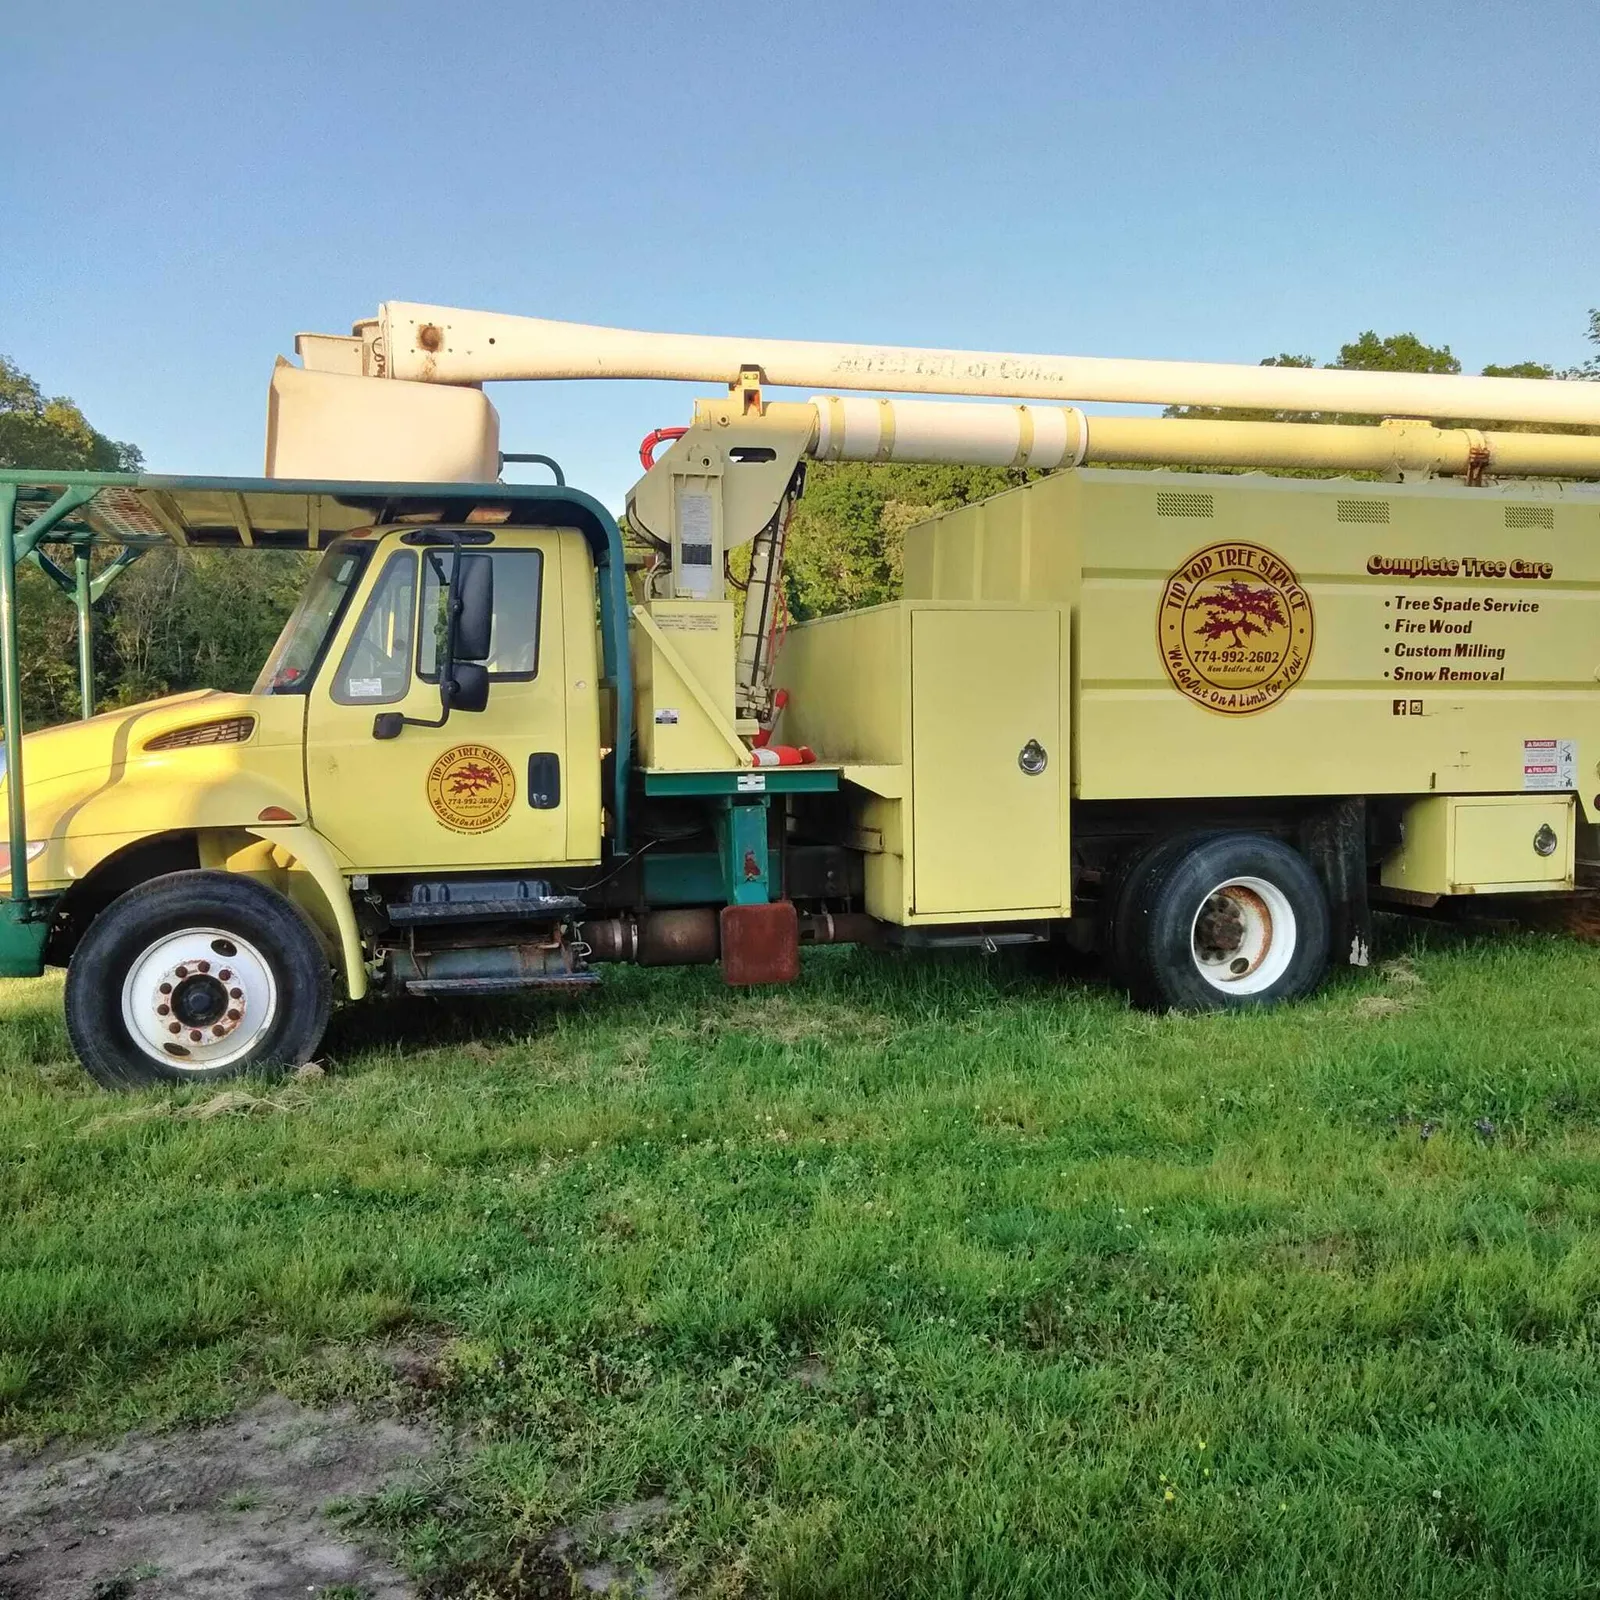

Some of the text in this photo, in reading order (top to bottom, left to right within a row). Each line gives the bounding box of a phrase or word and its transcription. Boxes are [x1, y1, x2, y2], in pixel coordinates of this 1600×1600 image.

[1366, 554, 1553, 579] Complete Tree Care
[1166, 548, 1308, 614] TIP TOP TREE SERVICE
[1395, 596, 1540, 613] Tree Spade Service
[1394, 619, 1473, 634] Fire Wood
[1194, 650, 1279, 663] 774-992-2602
[1394, 642, 1506, 660] Custom Milling
[1207, 665, 1222, 673] New
[1393, 667, 1505, 681] Snow Removal
[1177, 668, 1191, 684] Go
[1186, 680, 1209, 698] Out
[1210, 691, 1228, 706] On
[1227, 694, 1237, 707] A
[1239, 689, 1267, 706] Limb
[1265, 679, 1283, 697] For
[431, 747, 510, 781] TIP TOP TREE SERVICE
